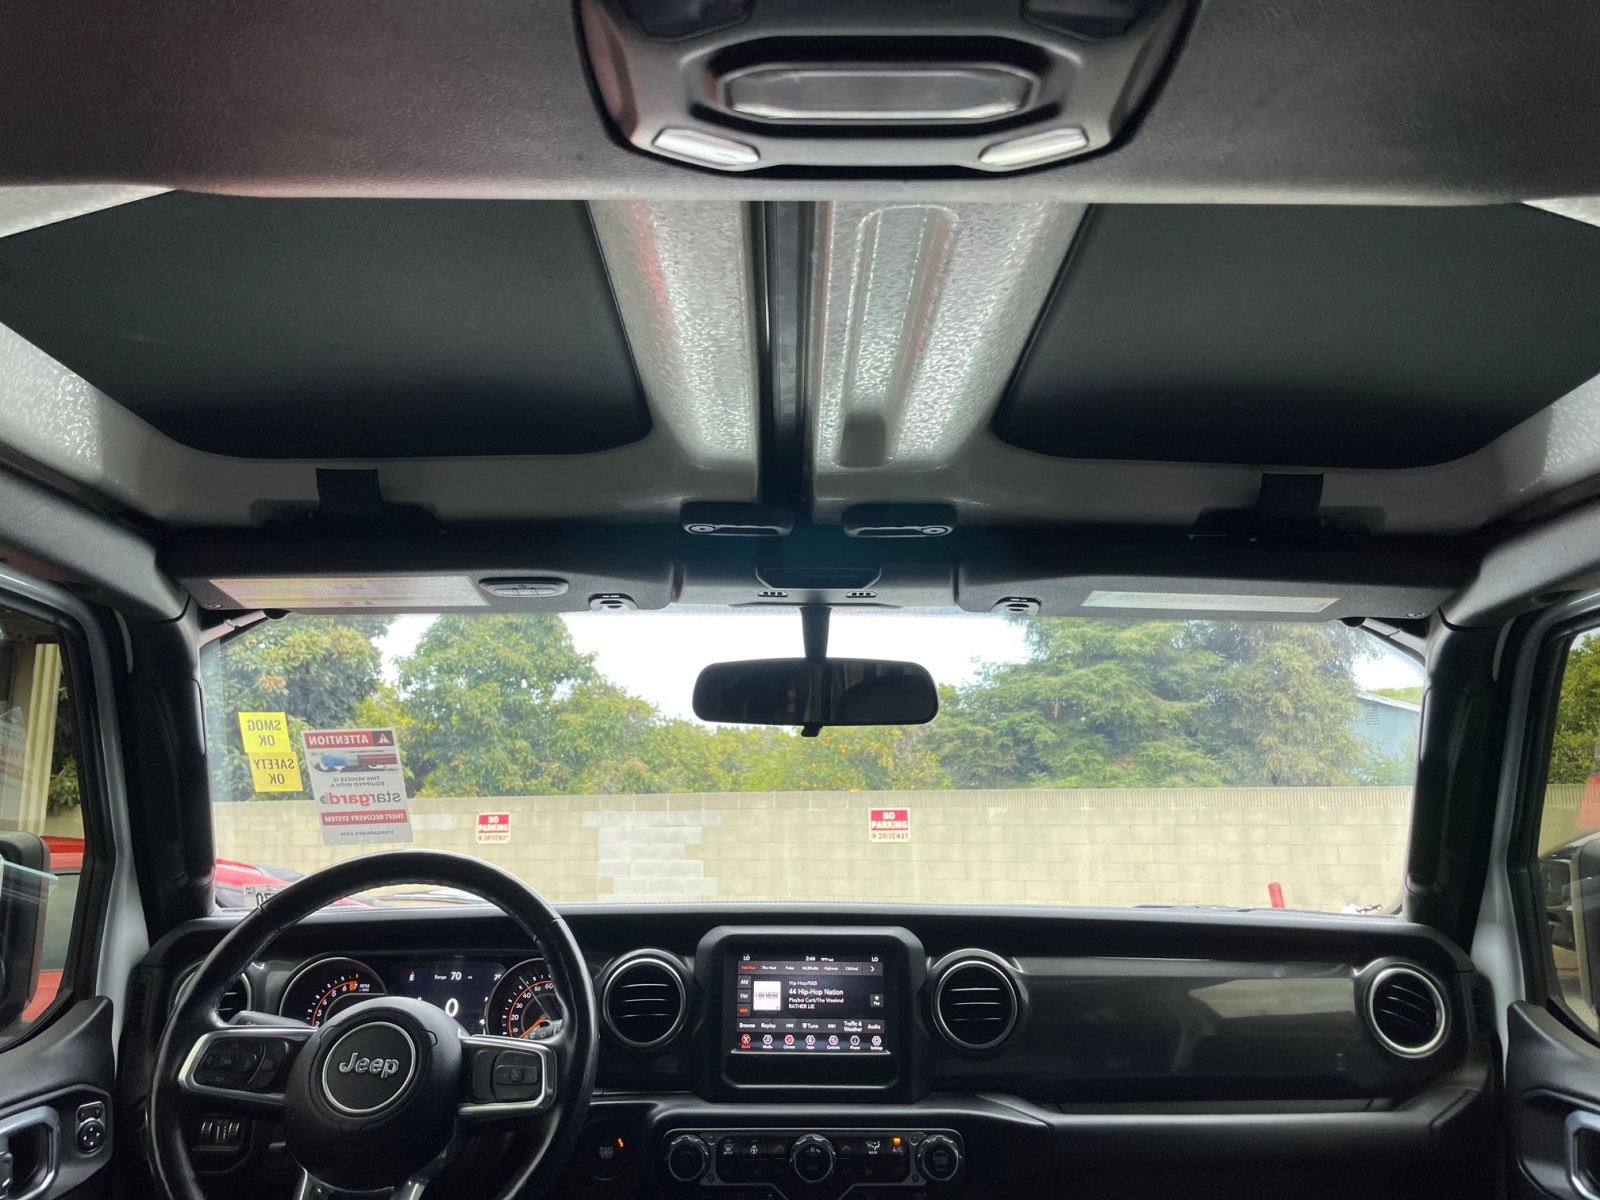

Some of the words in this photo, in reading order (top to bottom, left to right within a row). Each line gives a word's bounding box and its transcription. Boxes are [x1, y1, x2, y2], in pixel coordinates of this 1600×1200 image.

[488, 815, 499, 824] NO
[883, 811, 896, 820] NO
[871, 820, 908, 829] PARKING
[450, 971, 462, 981] 70
[342, 984, 347, 992] 6
[797, 988, 823, 997] Hip-Hop
[823, 988, 844, 996] Nation
[331, 990, 337, 998] 5
[445, 997, 459, 1018] 0
[316, 1009, 322, 1017] 3
[339, 1052, 399, 1079] Jeep
